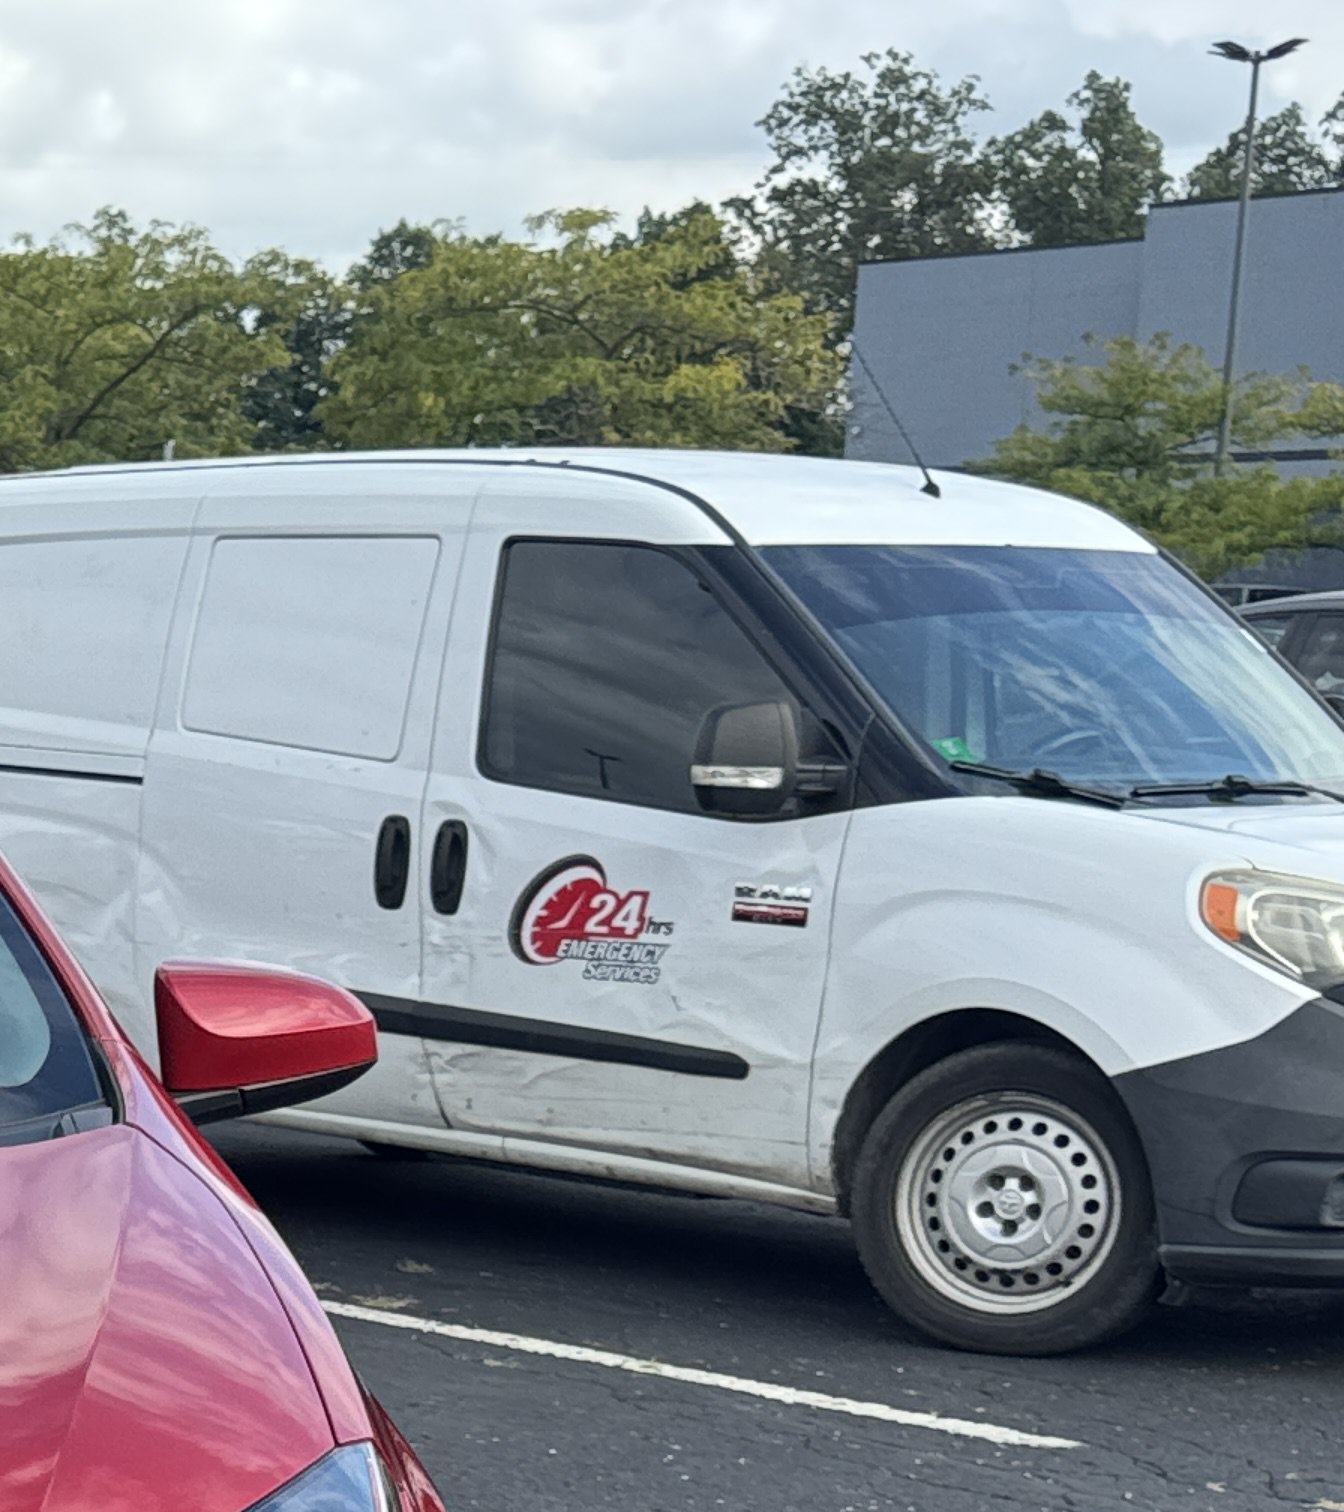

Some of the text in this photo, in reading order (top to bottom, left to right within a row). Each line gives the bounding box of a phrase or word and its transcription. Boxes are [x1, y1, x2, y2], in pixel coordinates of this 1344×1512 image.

[583, 892, 674, 936] 24 hrs
[556, 939, 668, 964] EMERGENCY
[582, 961, 661, 984] Services
